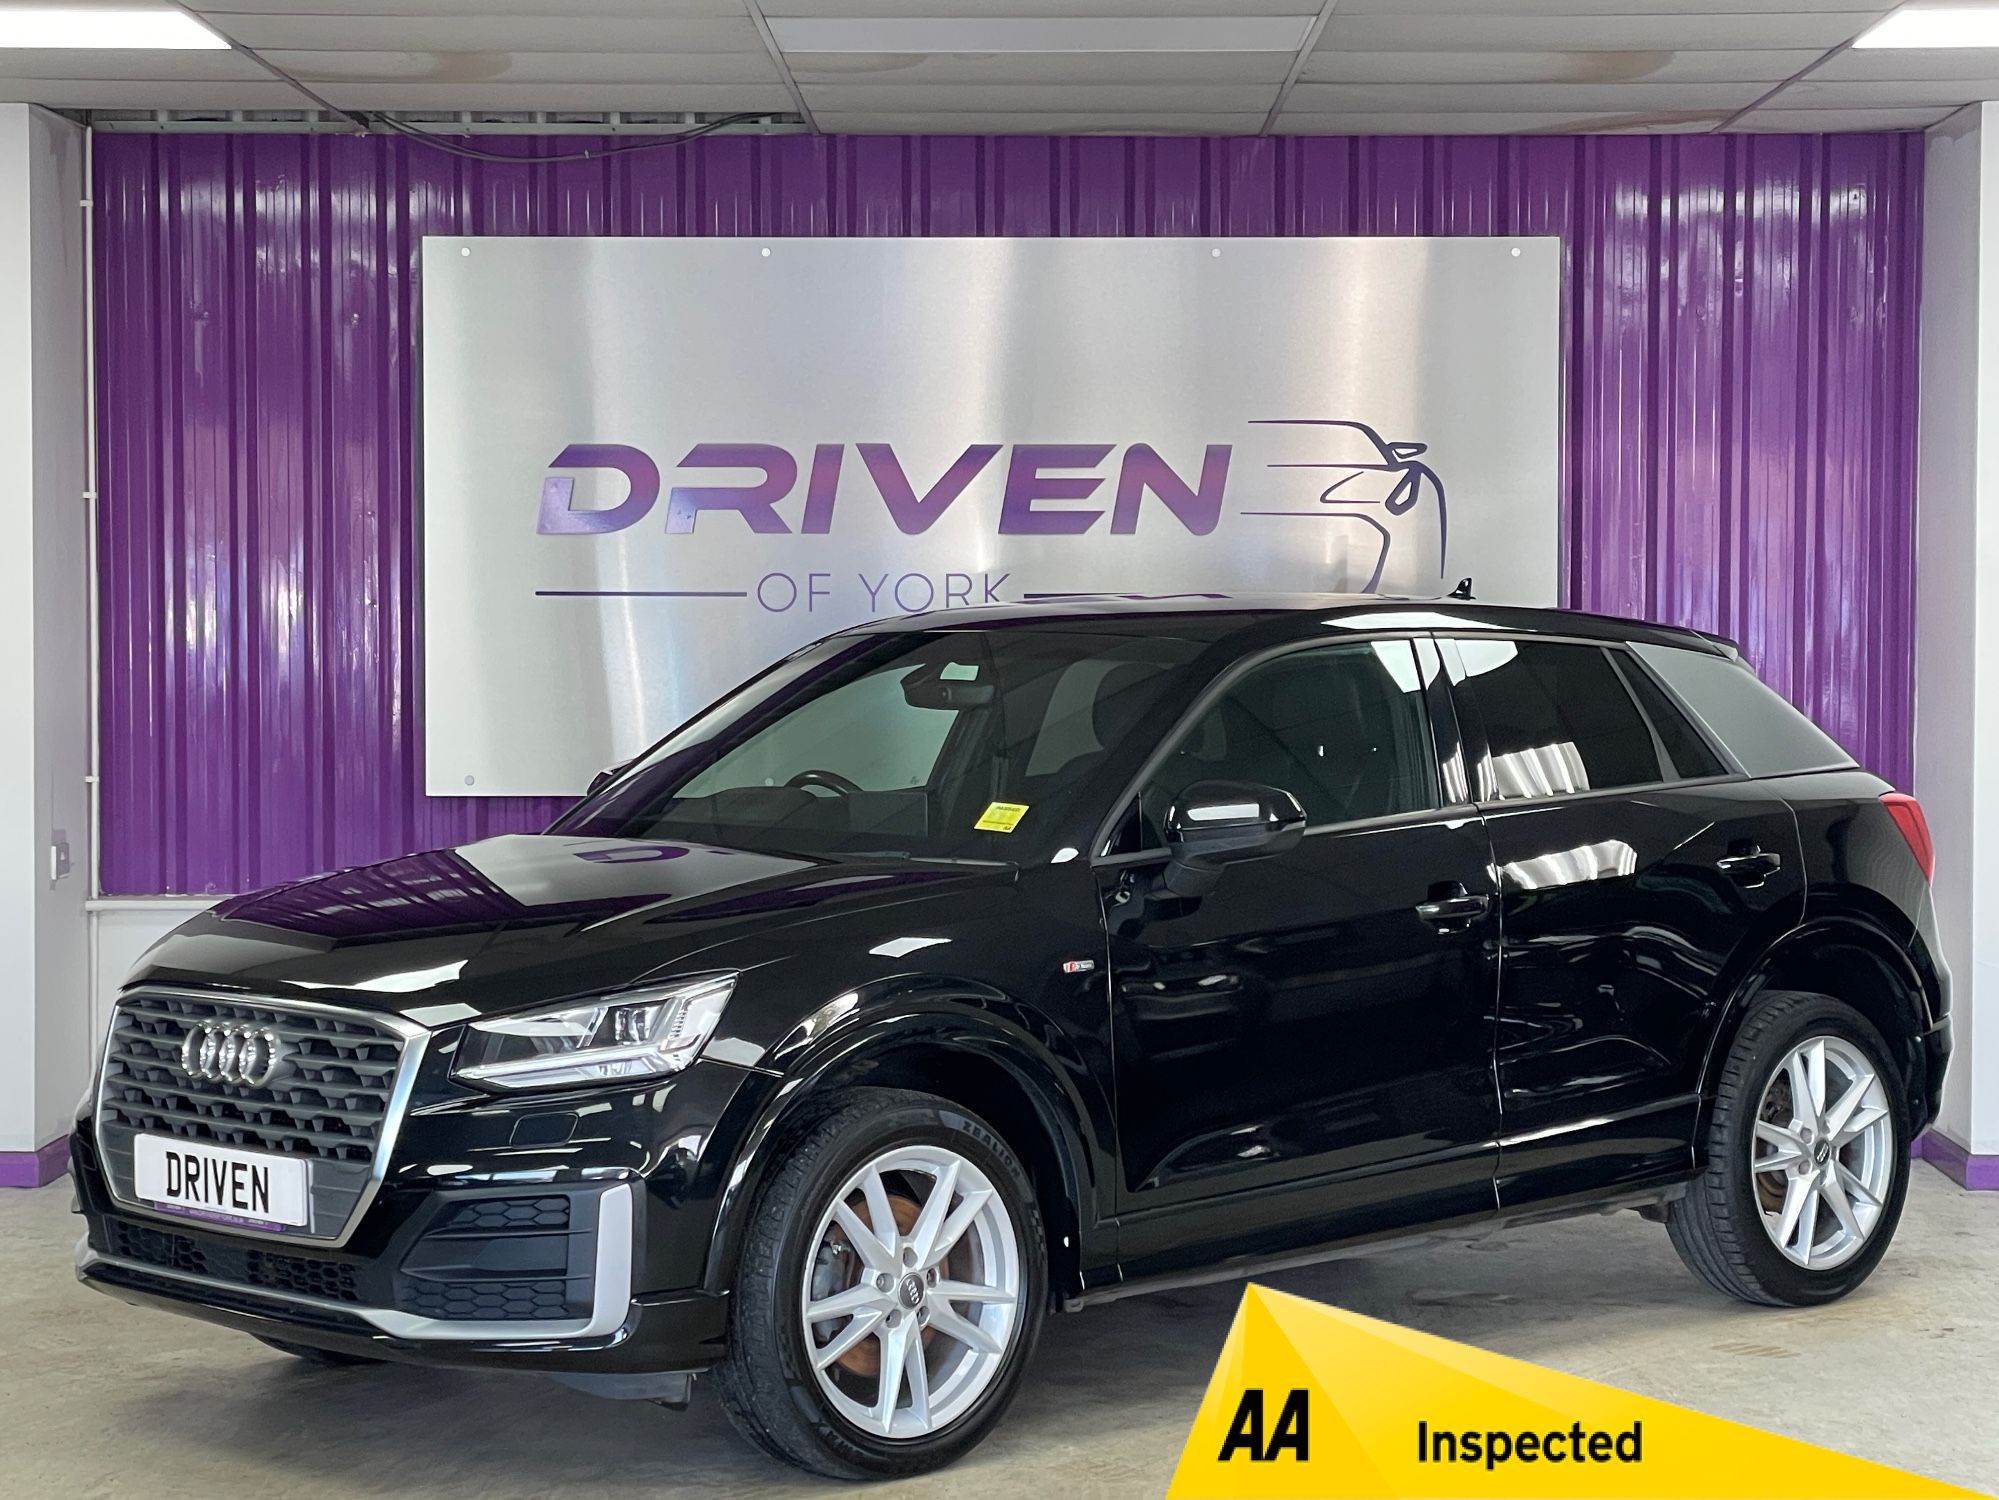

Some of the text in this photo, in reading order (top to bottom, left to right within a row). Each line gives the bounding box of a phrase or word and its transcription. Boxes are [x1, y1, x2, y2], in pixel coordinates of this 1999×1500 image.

[536, 443, 1233, 536] DRIVEN
[757, 572, 1011, 612] OF YORK
[166, 1151, 269, 1213] DRIVEN
